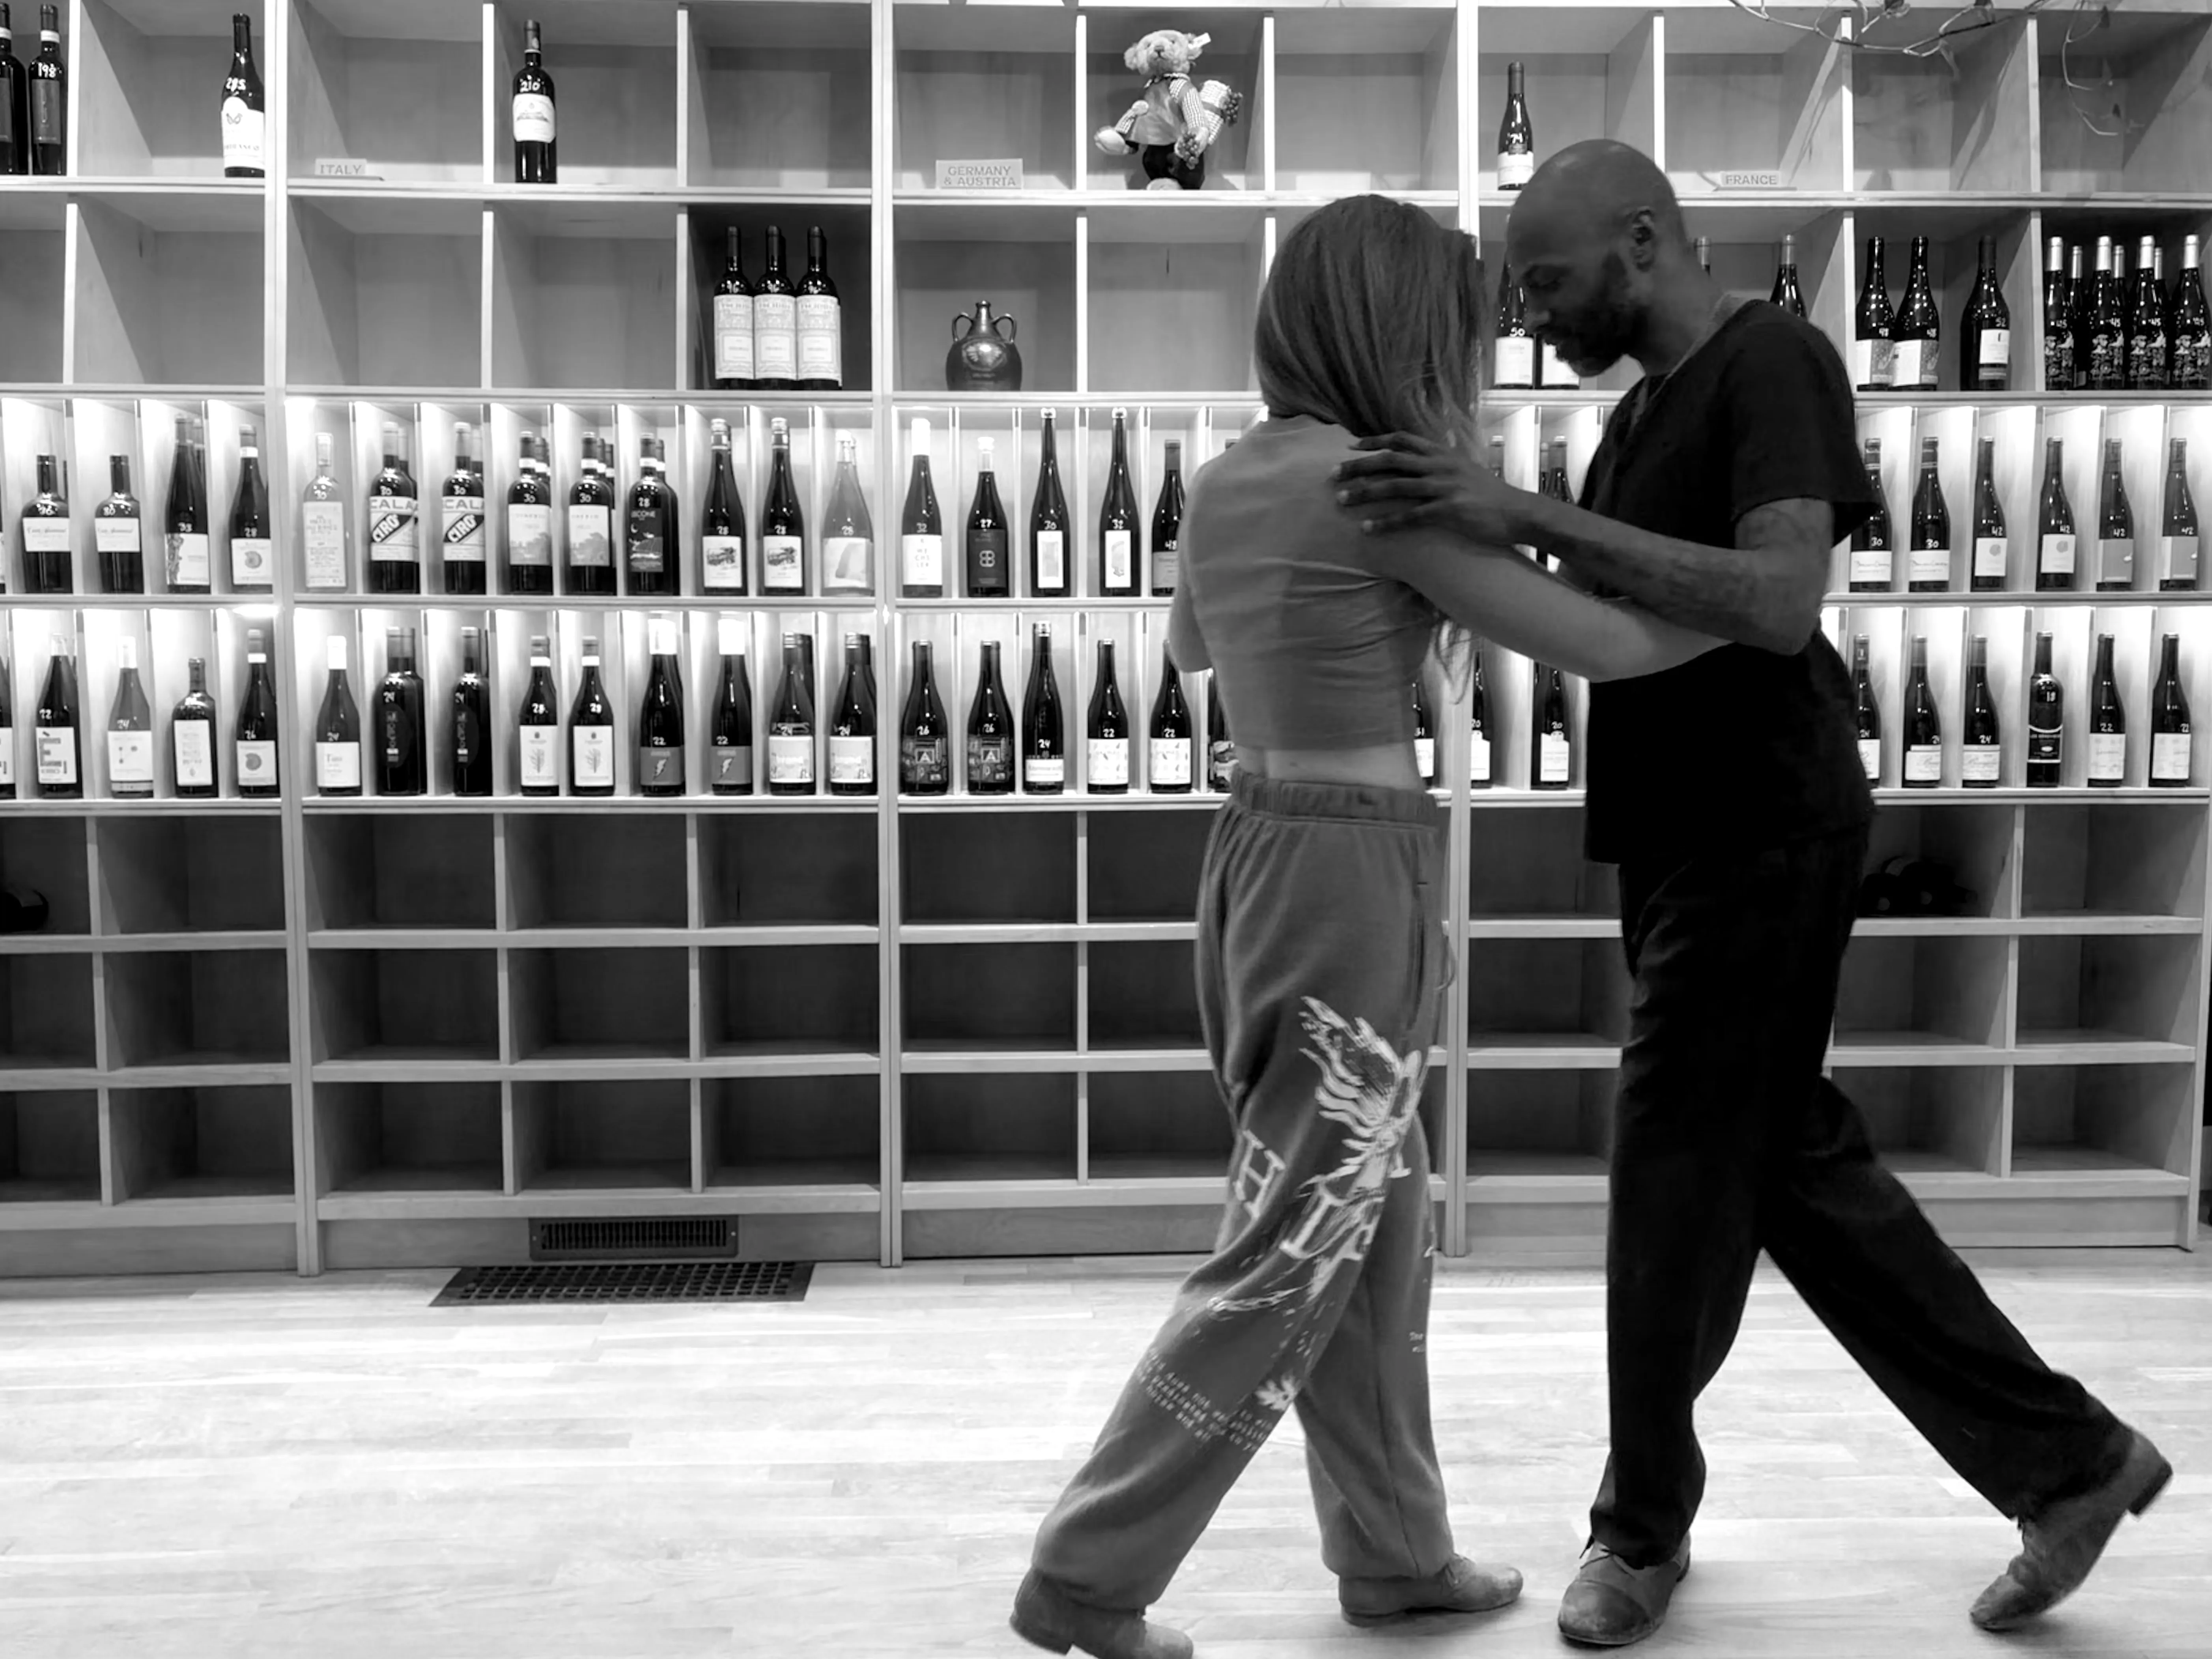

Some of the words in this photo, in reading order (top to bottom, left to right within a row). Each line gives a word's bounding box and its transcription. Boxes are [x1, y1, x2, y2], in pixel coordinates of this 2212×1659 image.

[38, 63, 56, 78] 198
[320, 164, 362, 174] ITALY
[948, 166, 1011, 176] GERMANY
[943, 177, 952, 185] &
[957, 177, 1016, 186] AUSTRIA
[1725, 175, 1777, 185] FRANCE
[453, 484, 467, 495] 30
[524, 493, 536, 503] 30
[579, 493, 592, 503] 30
[446, 499, 484, 509] CAL
[1870, 536, 1883, 547] 30
[1925, 538, 1939, 549] 30
[1551, 721, 1564, 730] 20
[1102, 728, 1115, 738] 22
[1979, 734, 1992, 744] 24
